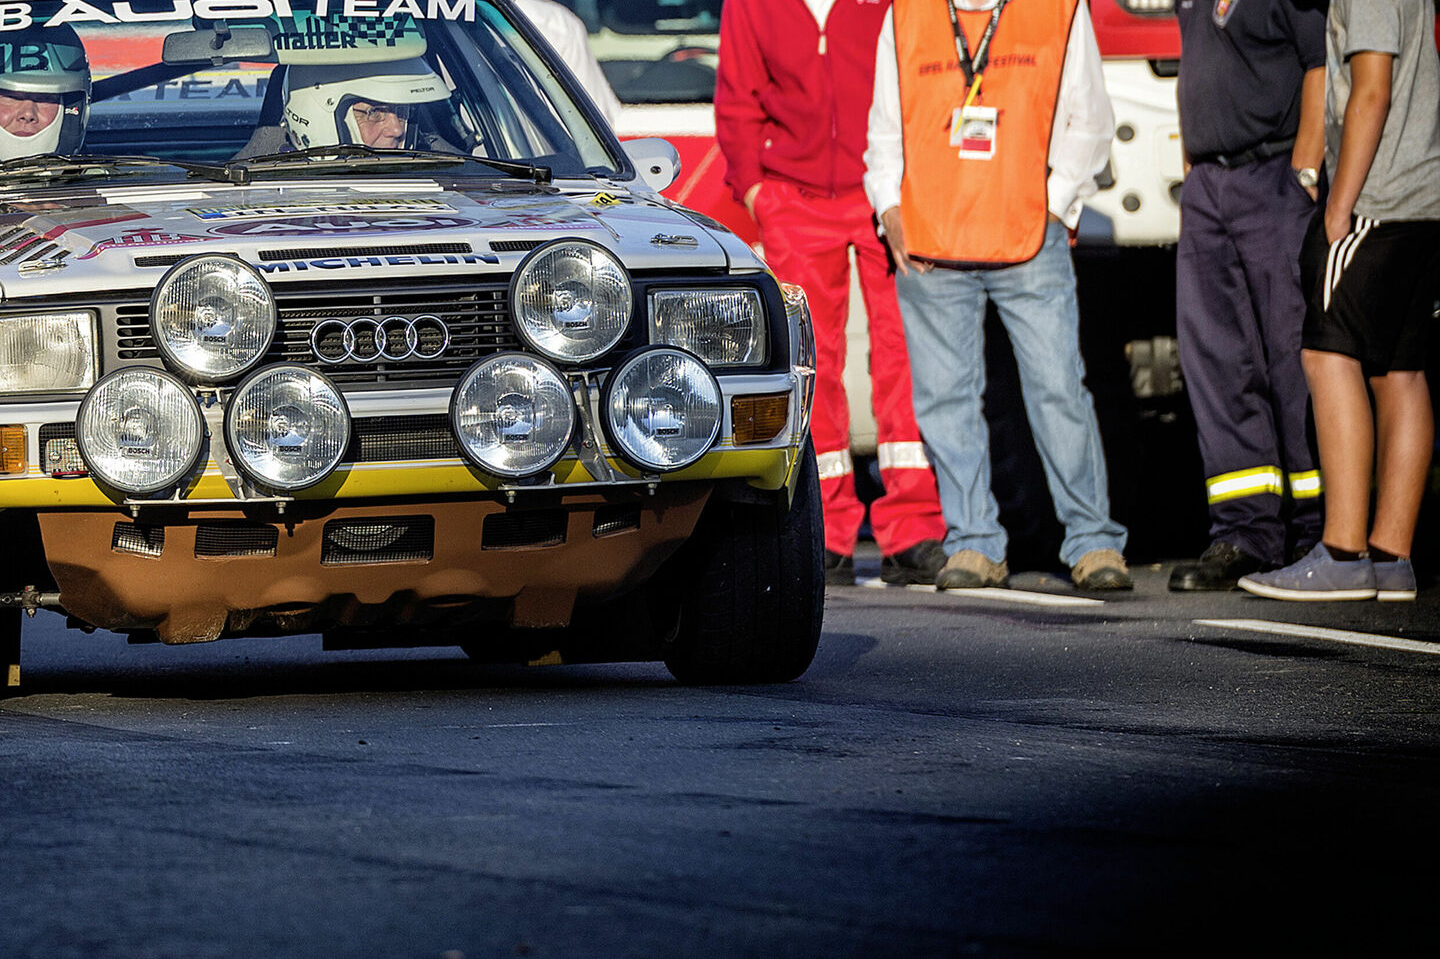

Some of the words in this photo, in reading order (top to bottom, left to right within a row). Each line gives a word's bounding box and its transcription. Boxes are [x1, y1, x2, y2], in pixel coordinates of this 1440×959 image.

[256, 254, 500, 274] MICHELIN
[203, 335, 226, 343] BOSCH
[127, 447, 150, 455] BOSCH
[279, 445, 302, 453] BOSCH
